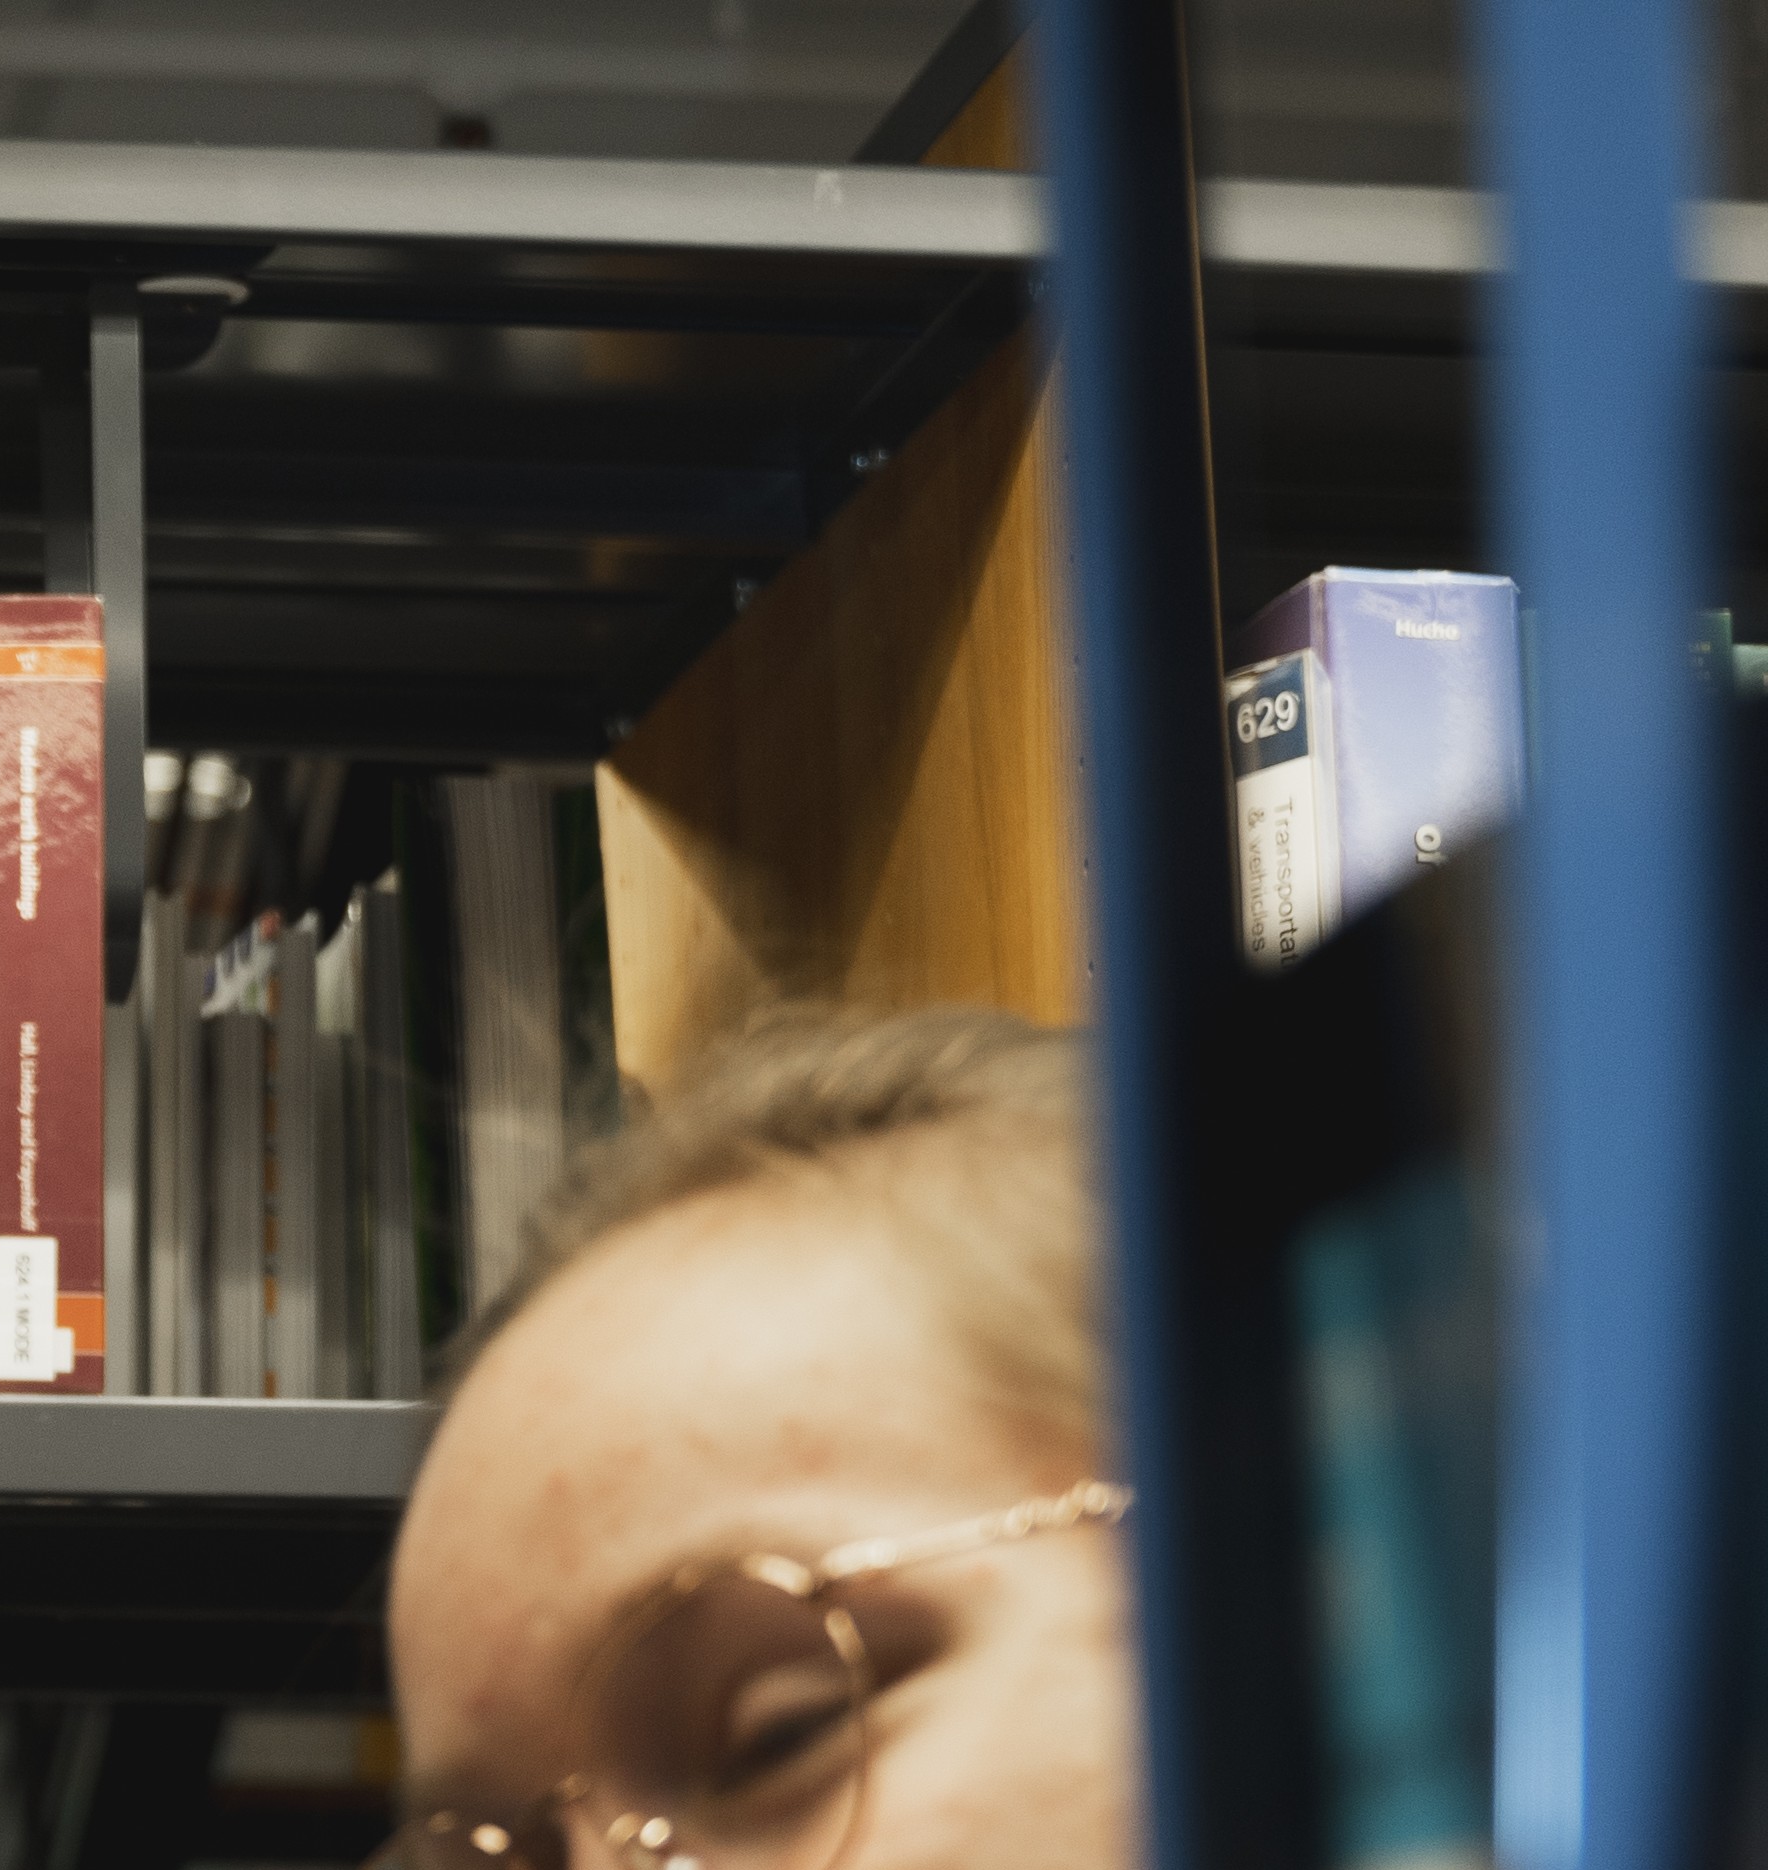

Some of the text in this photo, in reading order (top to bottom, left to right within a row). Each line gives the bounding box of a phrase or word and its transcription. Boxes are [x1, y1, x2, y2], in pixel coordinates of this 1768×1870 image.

[1394, 618, 1462, 641] Hucho
[1237, 690, 1301, 744] 629
[19, 796, 40, 842] earth
[1246, 806, 1267, 830] &
[15, 842, 41, 921] buildings
[19, 1118, 38, 1147] and
